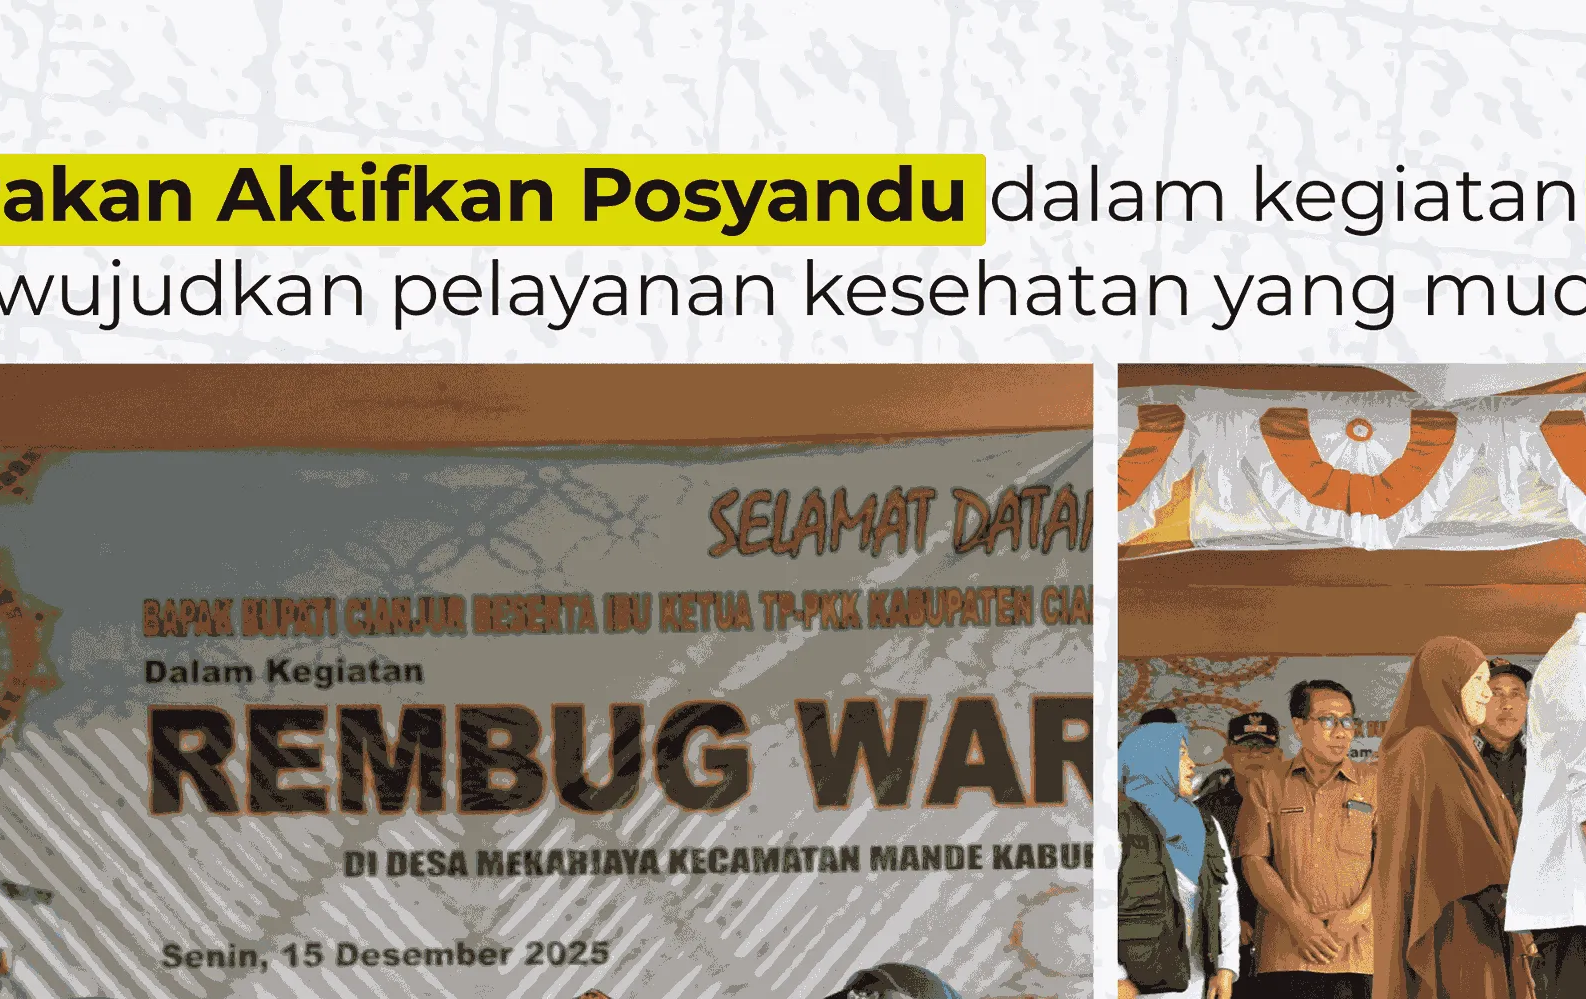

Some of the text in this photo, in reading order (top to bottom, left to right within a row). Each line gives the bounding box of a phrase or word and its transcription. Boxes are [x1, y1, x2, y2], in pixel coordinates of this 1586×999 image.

[709, 485, 937, 559] SELAMAT
[143, 585, 1093, 638] BAPAK BUPATI CIANJUR BESERTA IBU KETUA TP-PKK KABUPATEN CIA
[144, 656, 425, 690] Dalam Kegiatan
[148, 701, 752, 816] REMBUG
[344, 850, 377, 878] DI
[386, 850, 468, 877] DESA
[668, 846, 861, 875] KECAMATAN
[869, 844, 984, 872] MANDE
[162, 939, 612, 973] Senin, 15 Desember 2025
